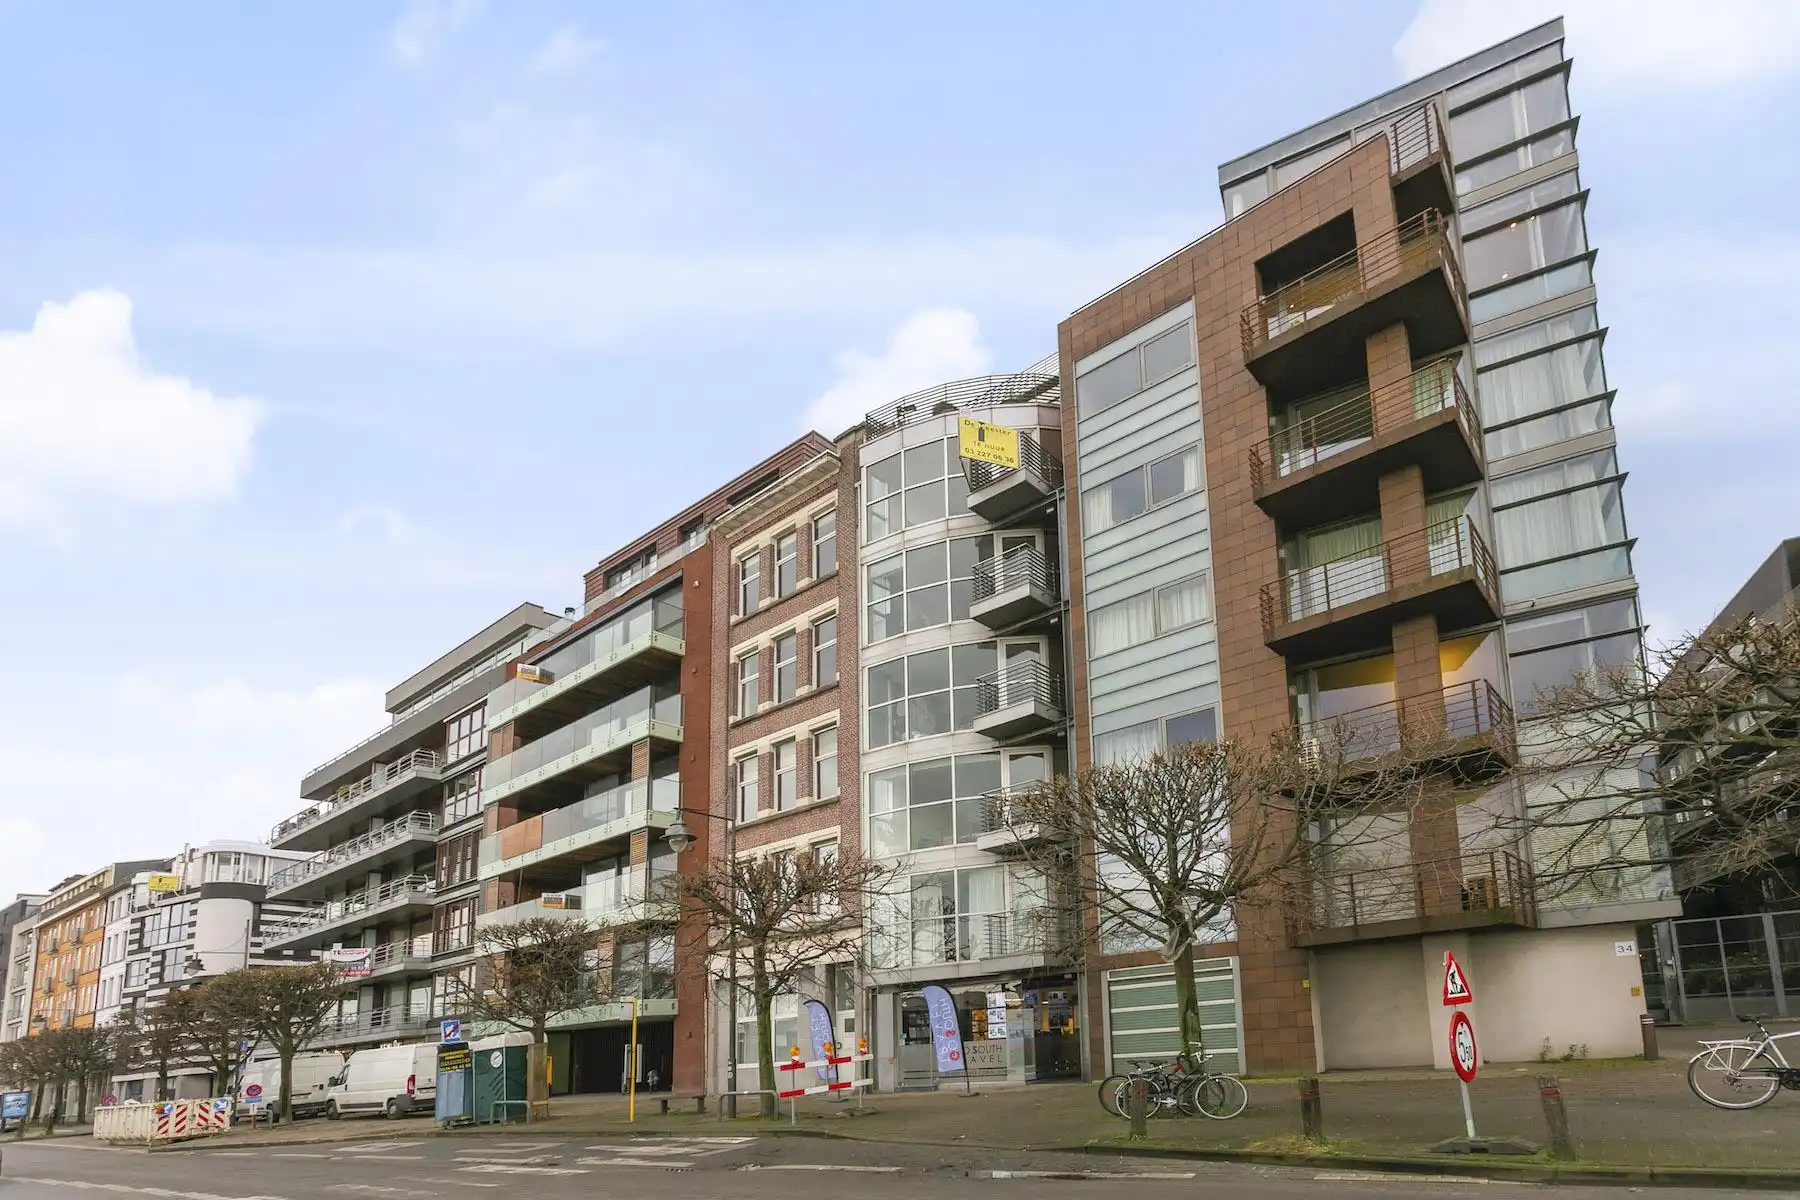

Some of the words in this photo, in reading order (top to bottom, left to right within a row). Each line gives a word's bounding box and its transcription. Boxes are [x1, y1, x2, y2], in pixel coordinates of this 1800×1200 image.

[964, 447, 974, 455] 03
[976, 450, 991, 458] 227
[984, 444, 1005, 452] HUUR
[1617, 944, 1633, 953] 34
[972, 1044, 1003, 1054] SOUTH
[970, 1054, 1002, 1064] AVEL
